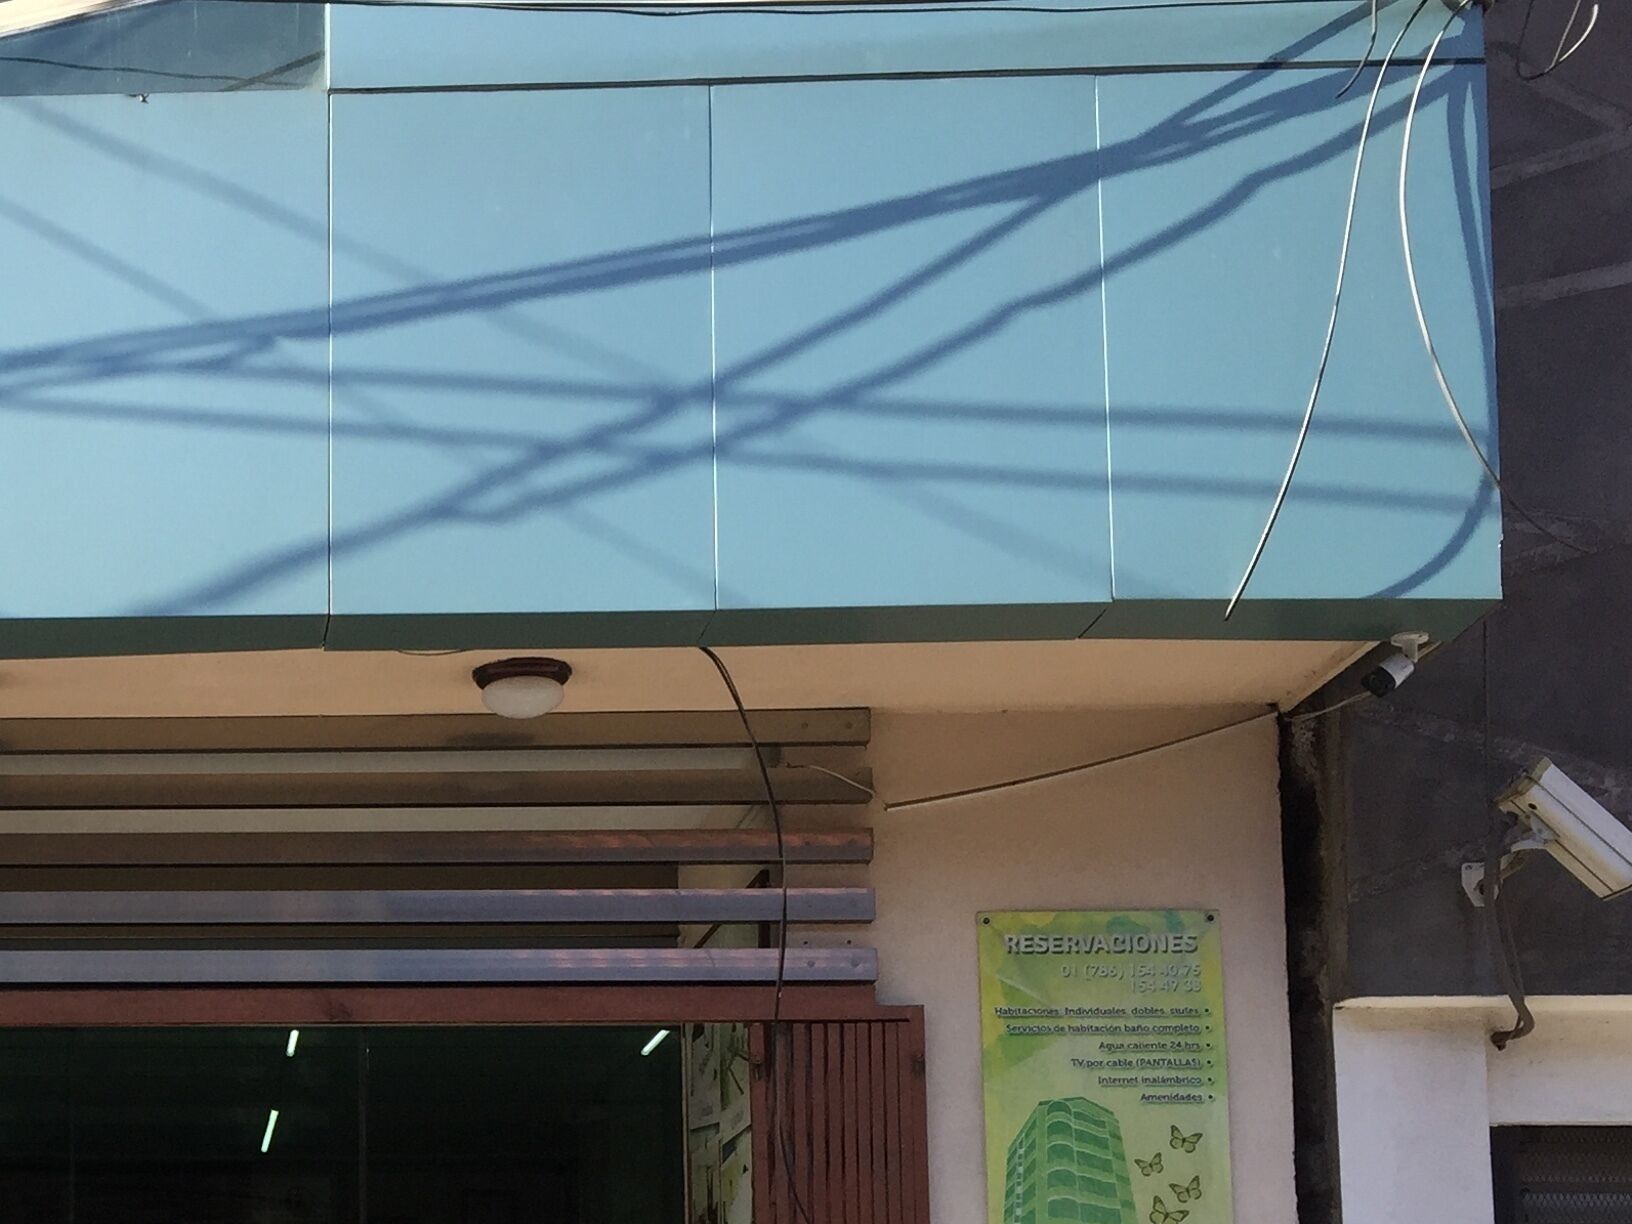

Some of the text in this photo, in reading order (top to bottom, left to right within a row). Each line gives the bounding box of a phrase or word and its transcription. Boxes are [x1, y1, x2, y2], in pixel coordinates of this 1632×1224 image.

[1004, 933, 1199, 955] RESERVACIONES
[1052, 1024, 1066, 1034] de
[1124, 1024, 1151, 1034] baño
[1152, 1024, 1201, 1036] completo
[1099, 1041, 1125, 1053] Agua
[1169, 1041, 1182, 1051] 24
[1071, 1058, 1086, 1069] TV
[1088, 1060, 1104, 1071] por
[1106, 1058, 1133, 1070] cable
[1098, 1075, 1139, 1087] Internet
[1141, 1093, 1203, 1105] Amenidades
